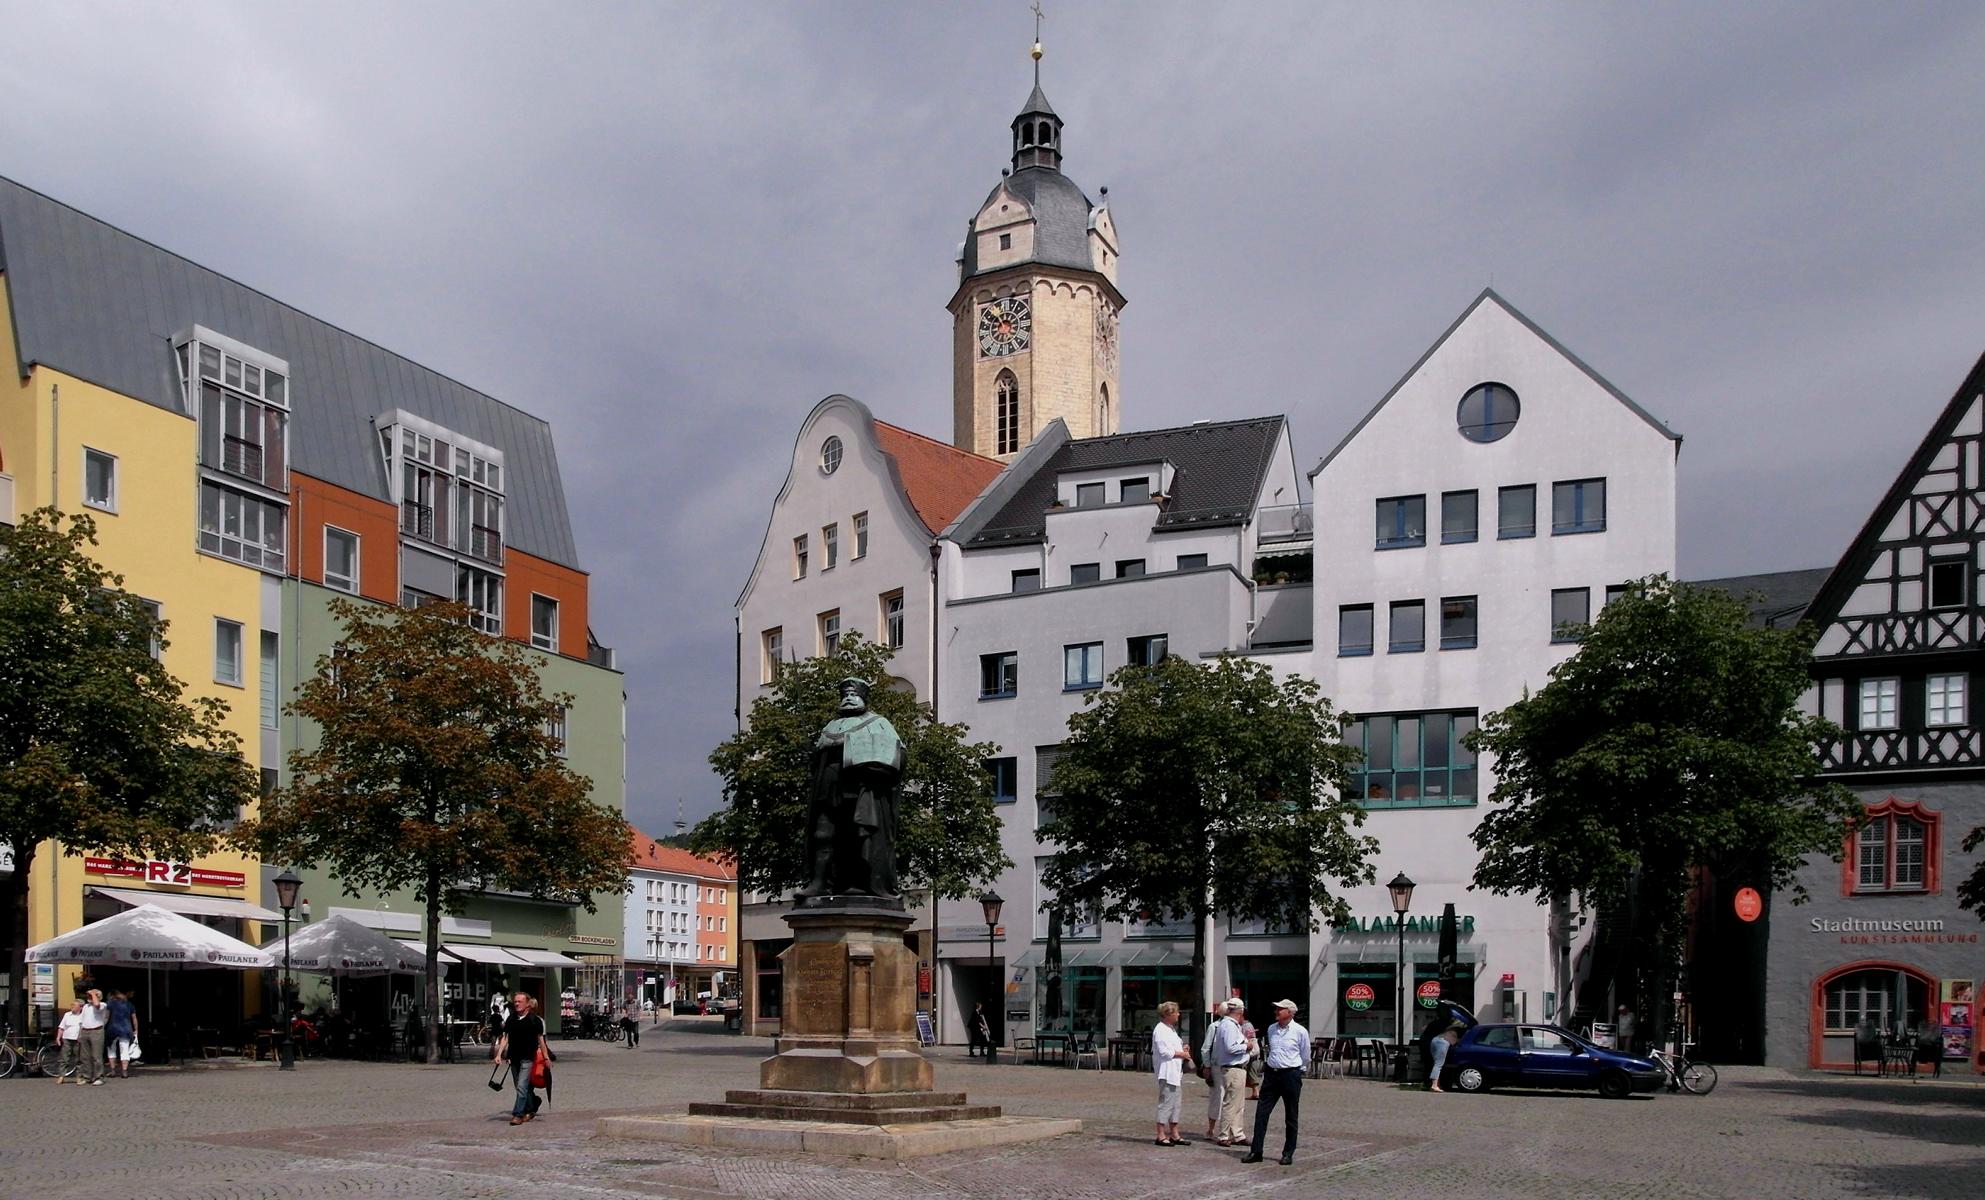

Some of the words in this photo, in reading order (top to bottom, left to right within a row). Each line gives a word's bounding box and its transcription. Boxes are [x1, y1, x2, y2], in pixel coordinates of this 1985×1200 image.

[1811, 916, 1943, 933] Stadtmuseum
[1840, 934, 1977, 945] KUNSTSAMMLUNG
[142, 951, 186, 959] PAULANER
[218, 954, 258, 964] PAULANER
[1351, 987, 1369, 995] 50%
[1351, 1001, 1368, 1009] 70%
